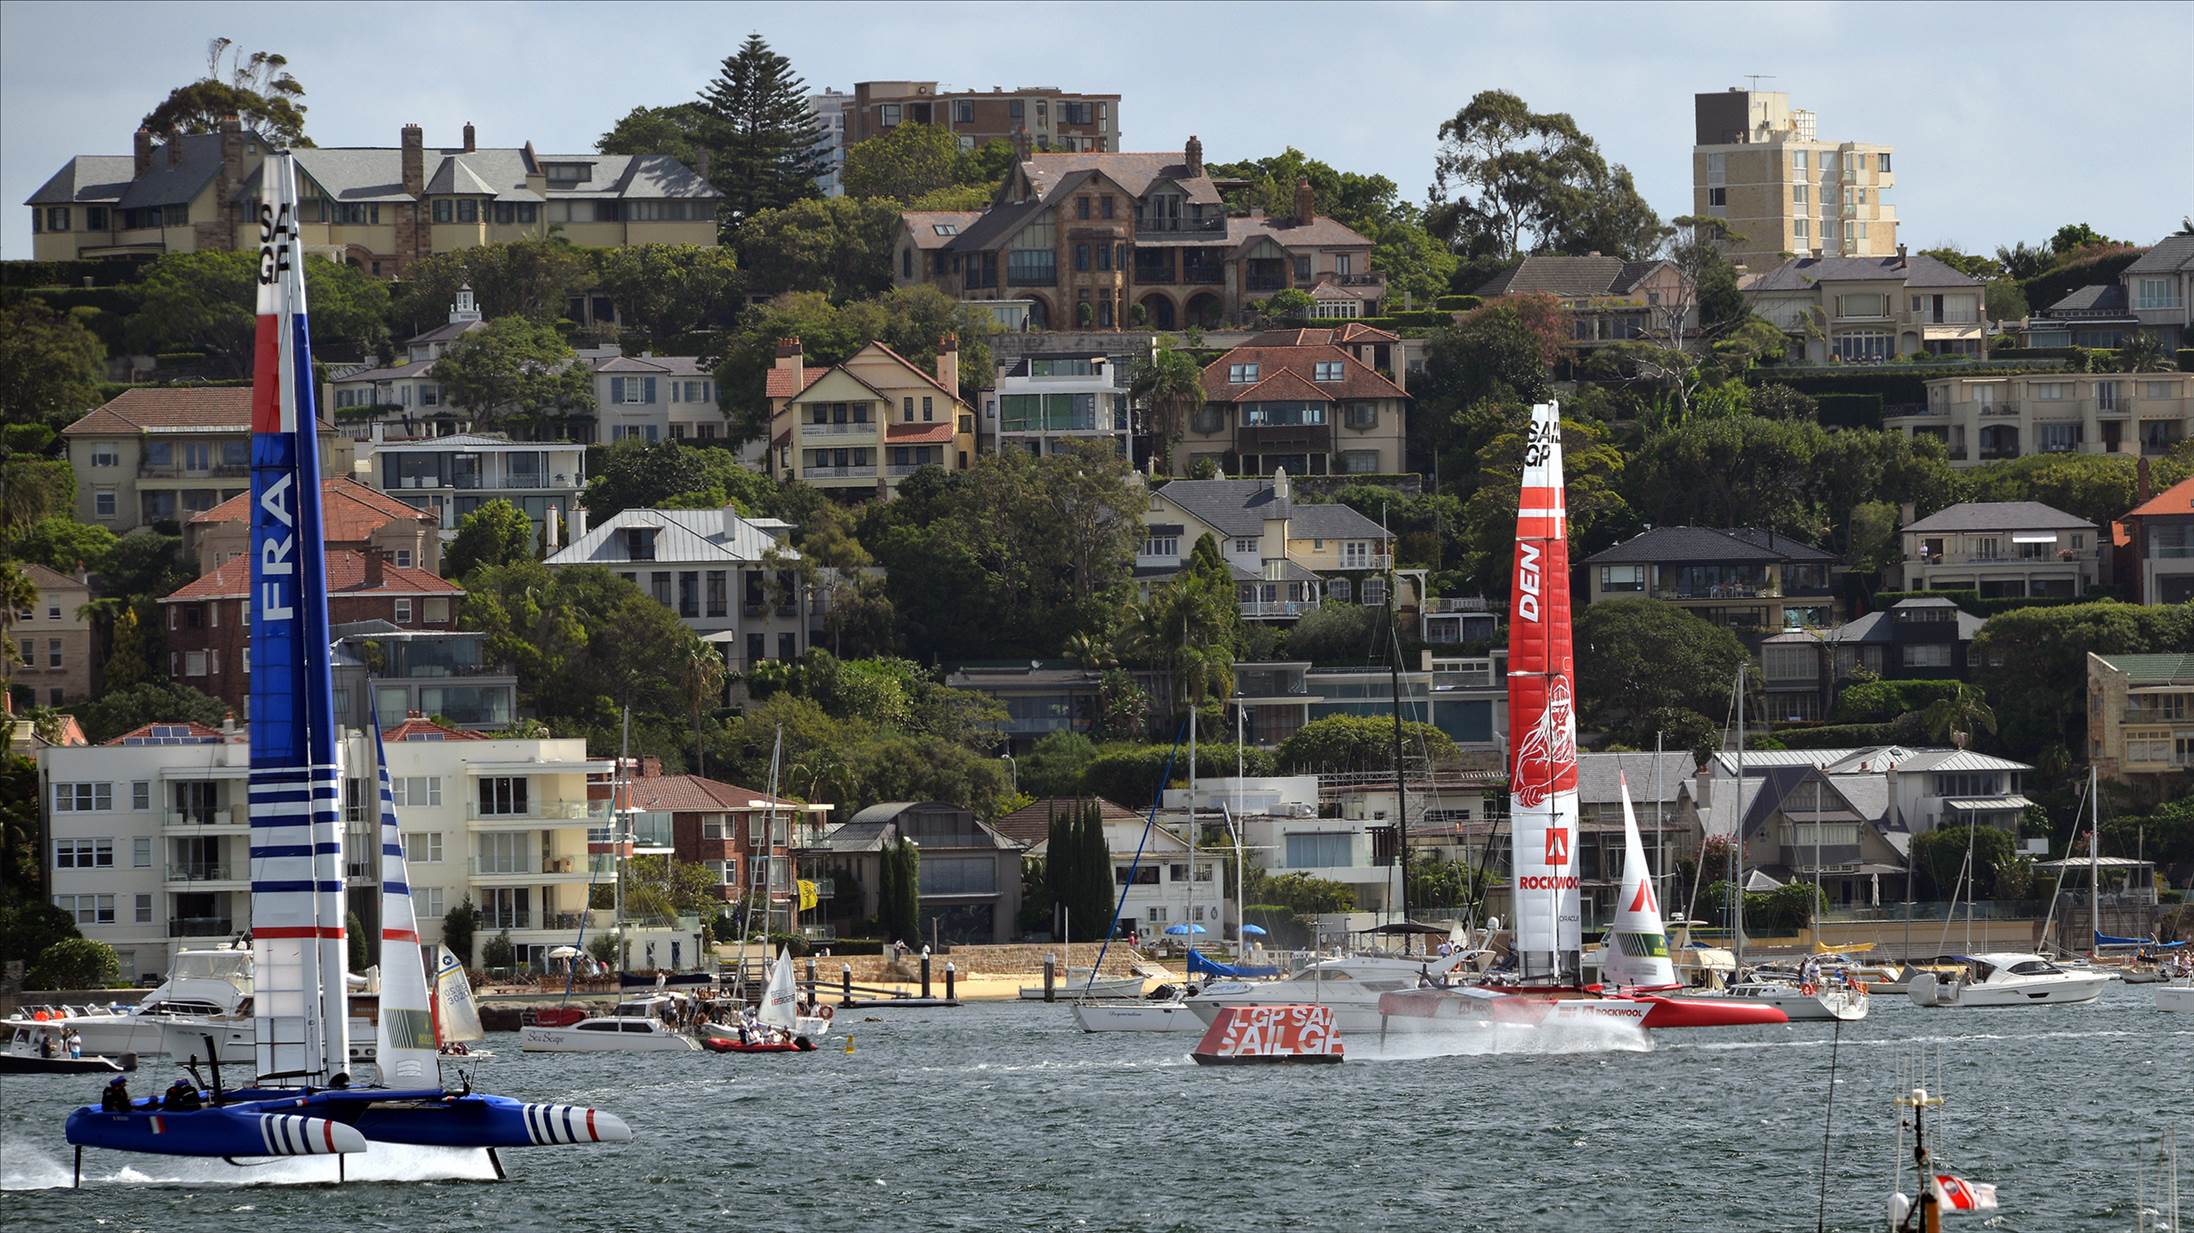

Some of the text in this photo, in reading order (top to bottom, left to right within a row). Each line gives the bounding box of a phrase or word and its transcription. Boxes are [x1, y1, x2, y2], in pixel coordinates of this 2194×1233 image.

[1525, 444, 1551, 468] GP
[261, 472, 294, 620] FRA
[1518, 542, 1540, 623] DEN
[1520, 876, 1579, 890] ROCKWOO
[1251, 1008, 1285, 1027] GP
[1291, 1008, 1333, 1026] SAI
[1596, 1007, 1643, 1018] ROCKWOOL
[1219, 1025, 1293, 1055] SAIL
